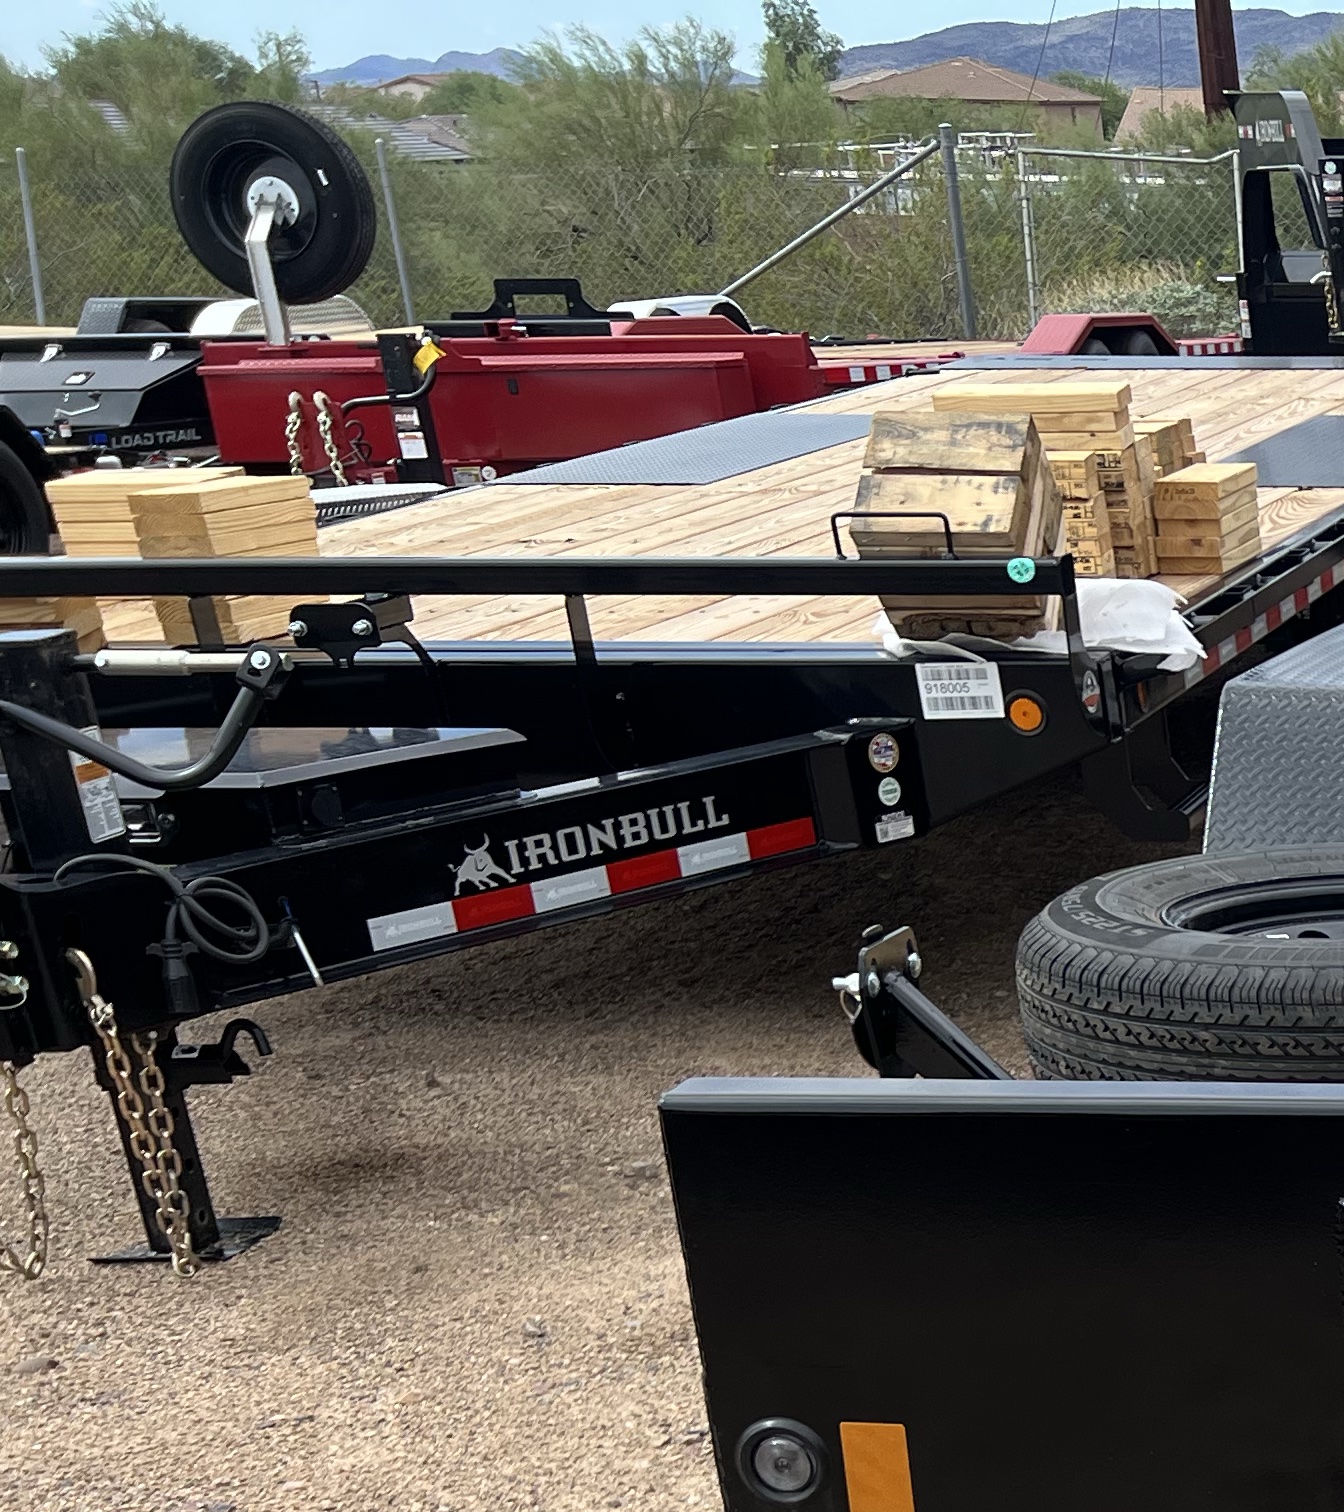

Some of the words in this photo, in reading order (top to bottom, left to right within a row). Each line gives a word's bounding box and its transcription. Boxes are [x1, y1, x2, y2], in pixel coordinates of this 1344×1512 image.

[111, 433, 155, 449] LOAD
[156, 428, 202, 445] TRAIL
[924, 681, 971, 695] 918005
[504, 795, 731, 875] IRONBULL
